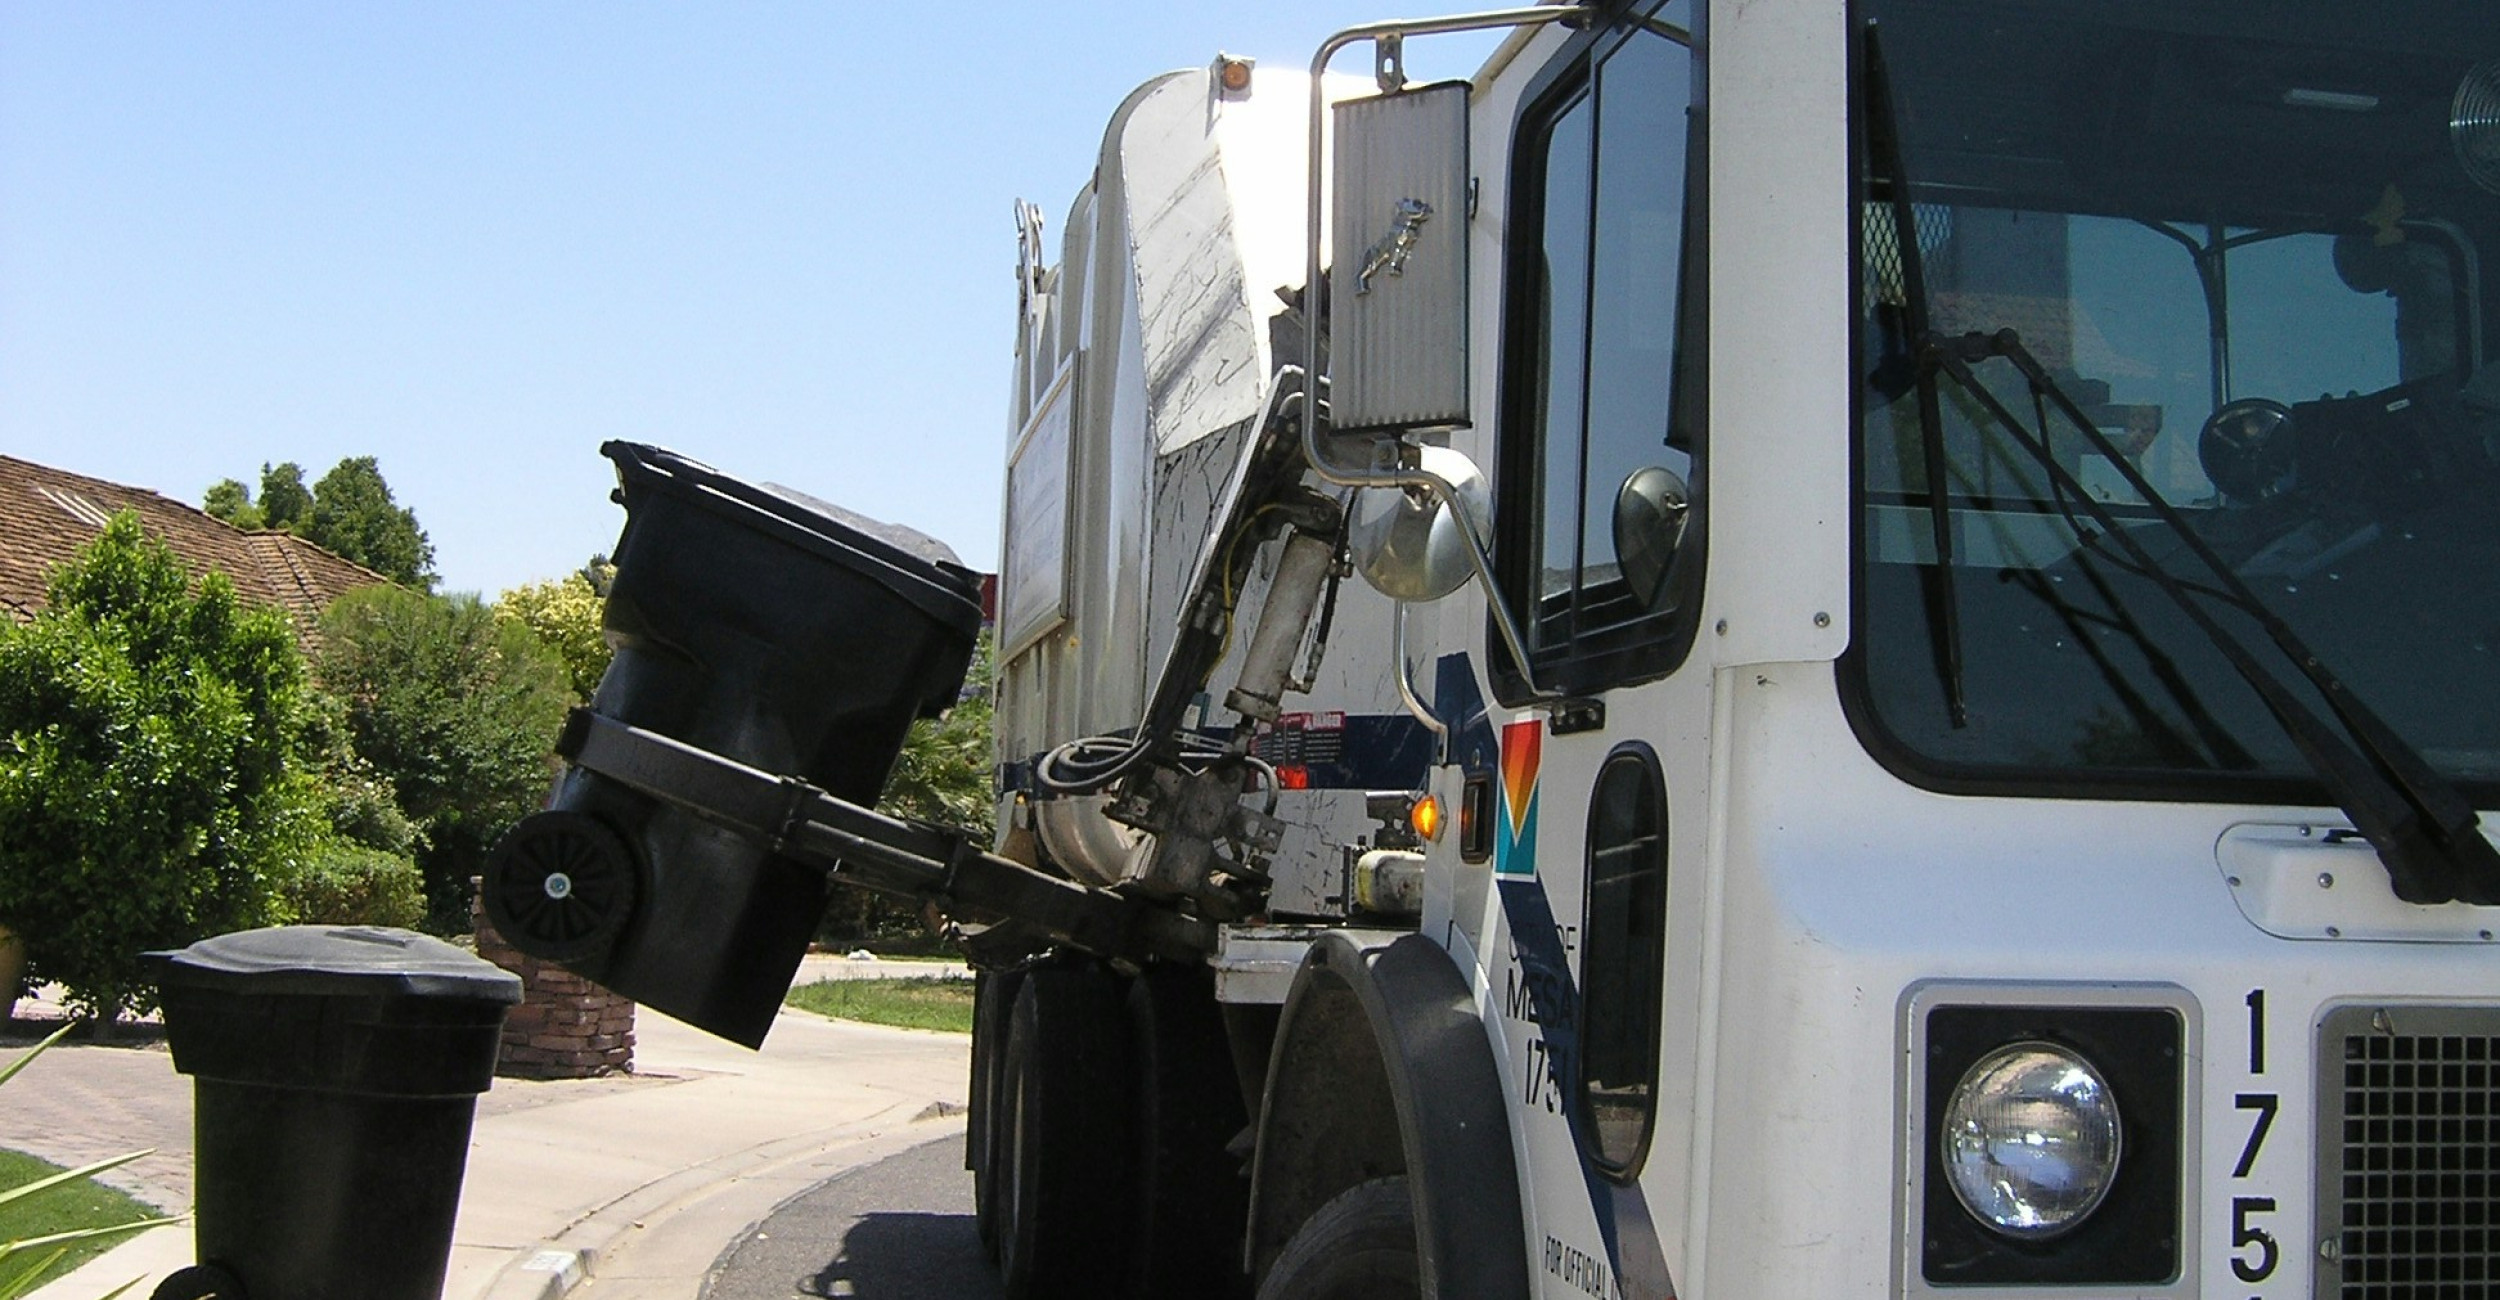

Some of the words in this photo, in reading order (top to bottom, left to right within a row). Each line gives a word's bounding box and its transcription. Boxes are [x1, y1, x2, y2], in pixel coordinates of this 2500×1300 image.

[1506, 968, 1575, 1031] MESA
[1545, 1236, 1562, 1277] FOR
[1564, 1246, 1606, 1300] OFFICIAL
